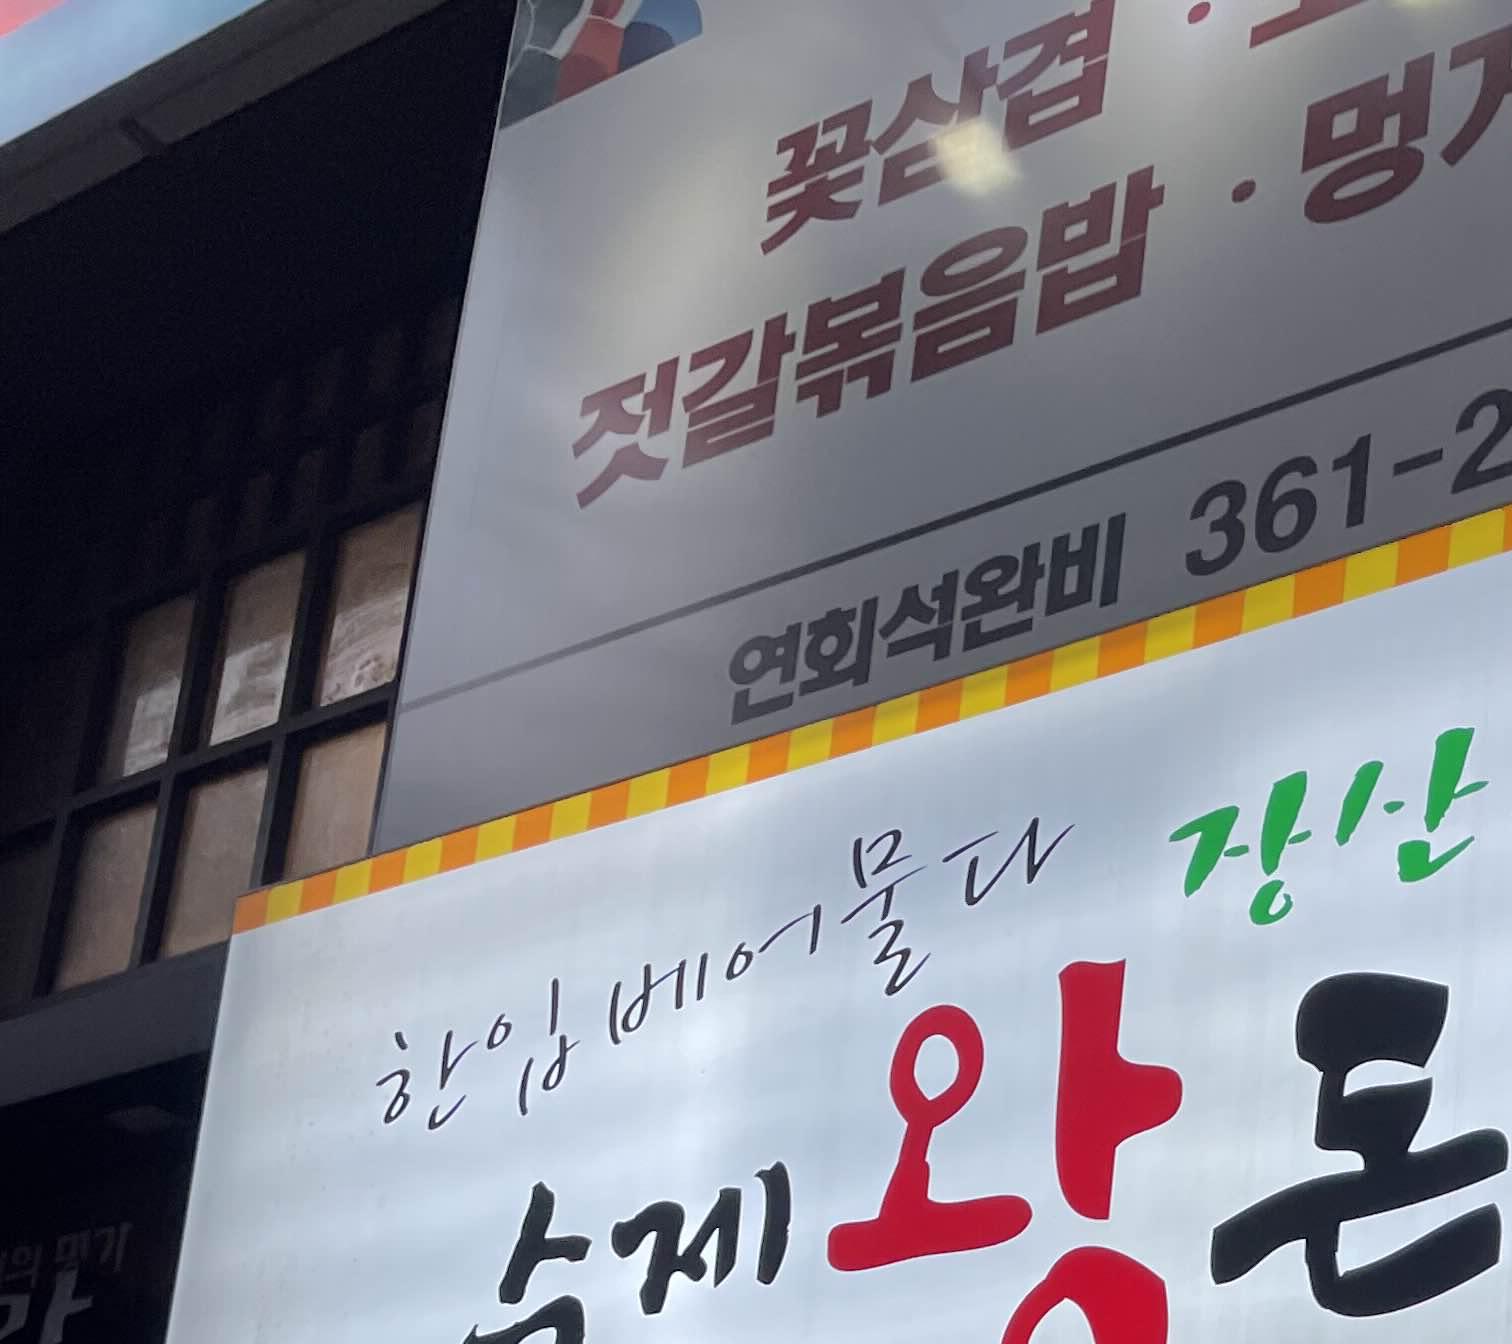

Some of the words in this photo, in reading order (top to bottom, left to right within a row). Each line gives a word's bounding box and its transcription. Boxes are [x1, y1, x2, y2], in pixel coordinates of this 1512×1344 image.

[572, 164, 1165, 510] 젓갈볶음밥
[728, 515, 1126, 724] 연회석완비
[376, 976, 582, 1132] 한입
